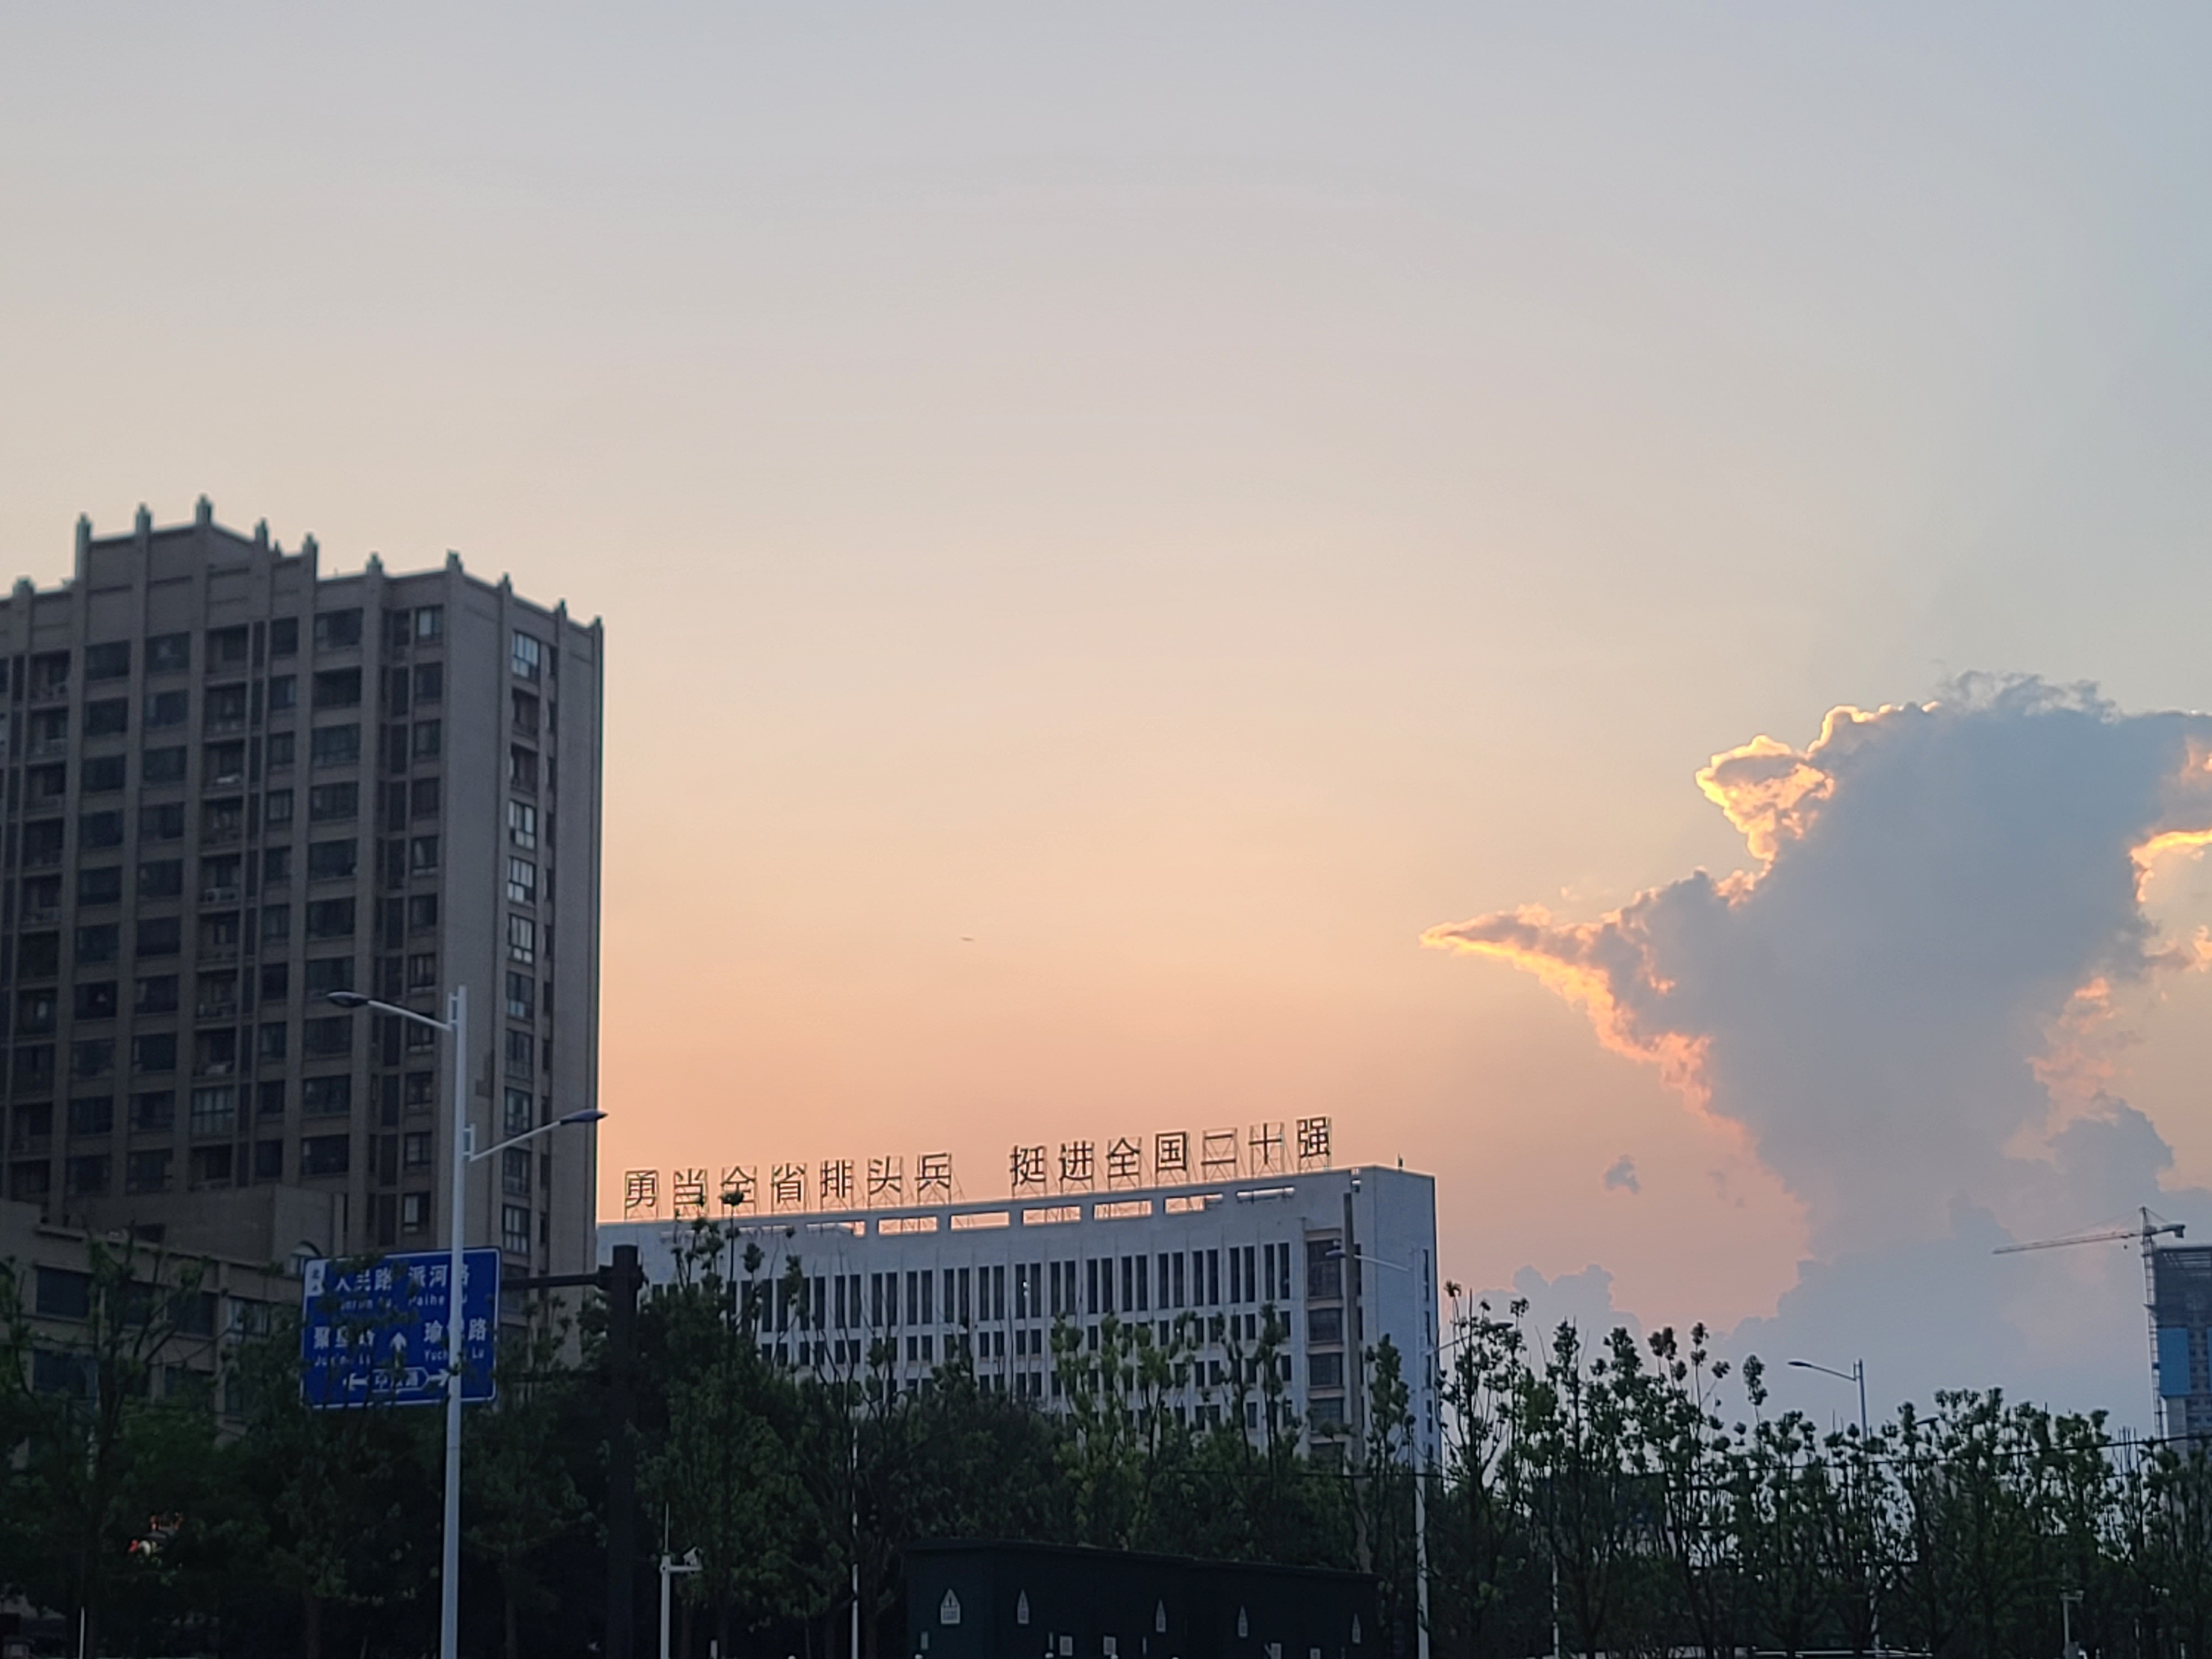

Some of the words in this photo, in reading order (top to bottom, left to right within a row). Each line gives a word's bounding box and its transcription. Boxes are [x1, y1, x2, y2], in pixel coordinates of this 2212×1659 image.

[625, 1153, 951, 1208] 勇当全省排头兵
[1010, 1117, 1331, 1186] 挺进全国二十强
[423, 1317, 487, 1344] 瑜路
